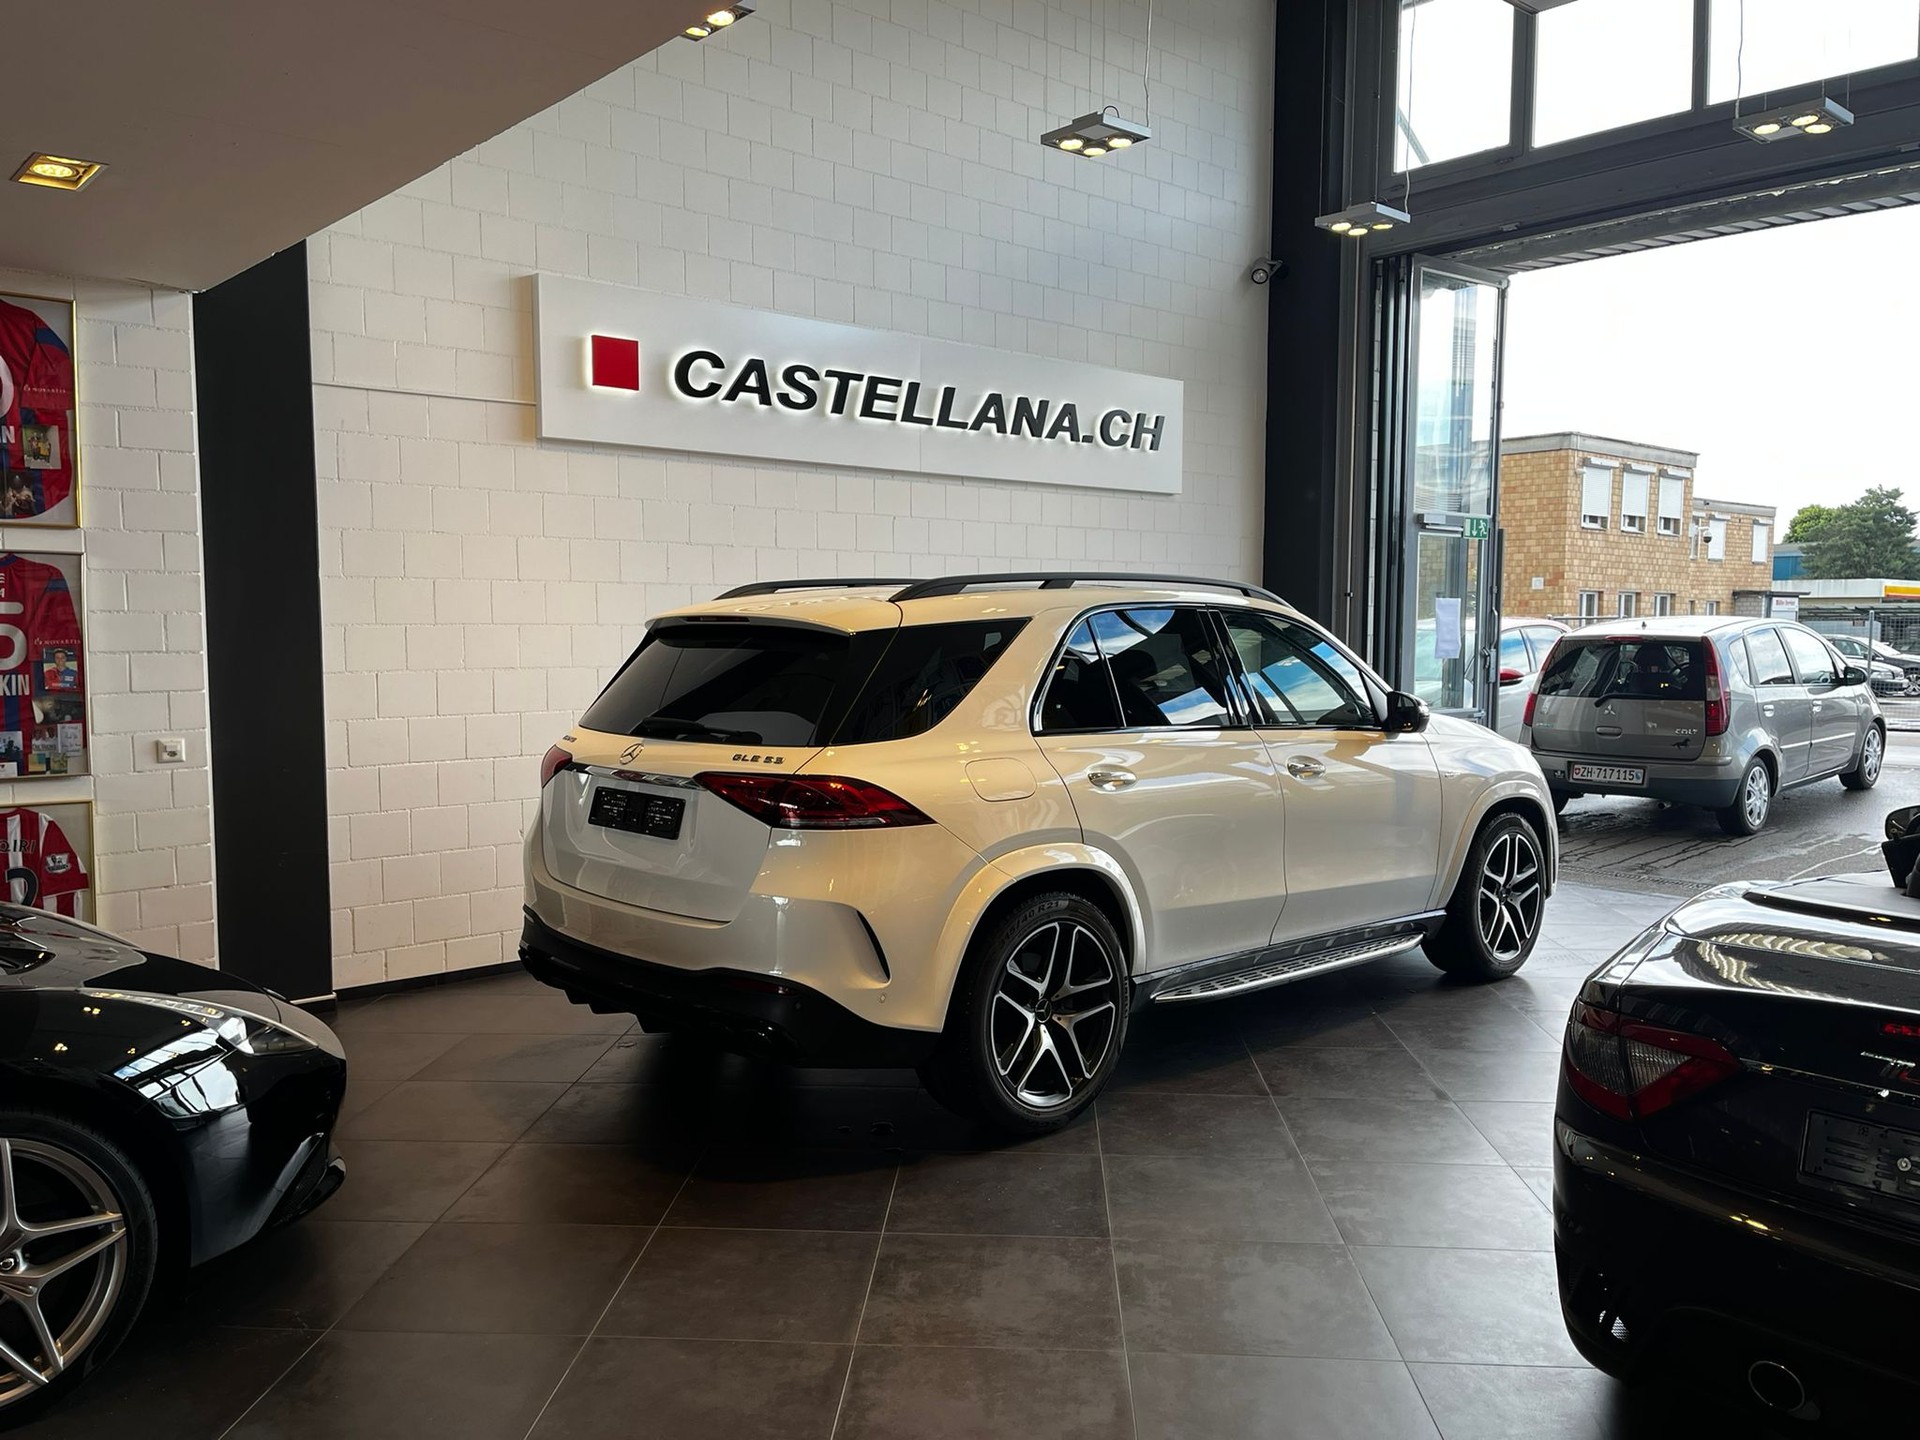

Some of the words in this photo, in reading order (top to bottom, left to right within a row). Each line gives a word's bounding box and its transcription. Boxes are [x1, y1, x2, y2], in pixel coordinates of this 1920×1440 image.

[674, 350, 1166, 451] CASTELLANA.CH
[732, 753, 761, 762] GLE
[763, 756, 786, 764] 53
